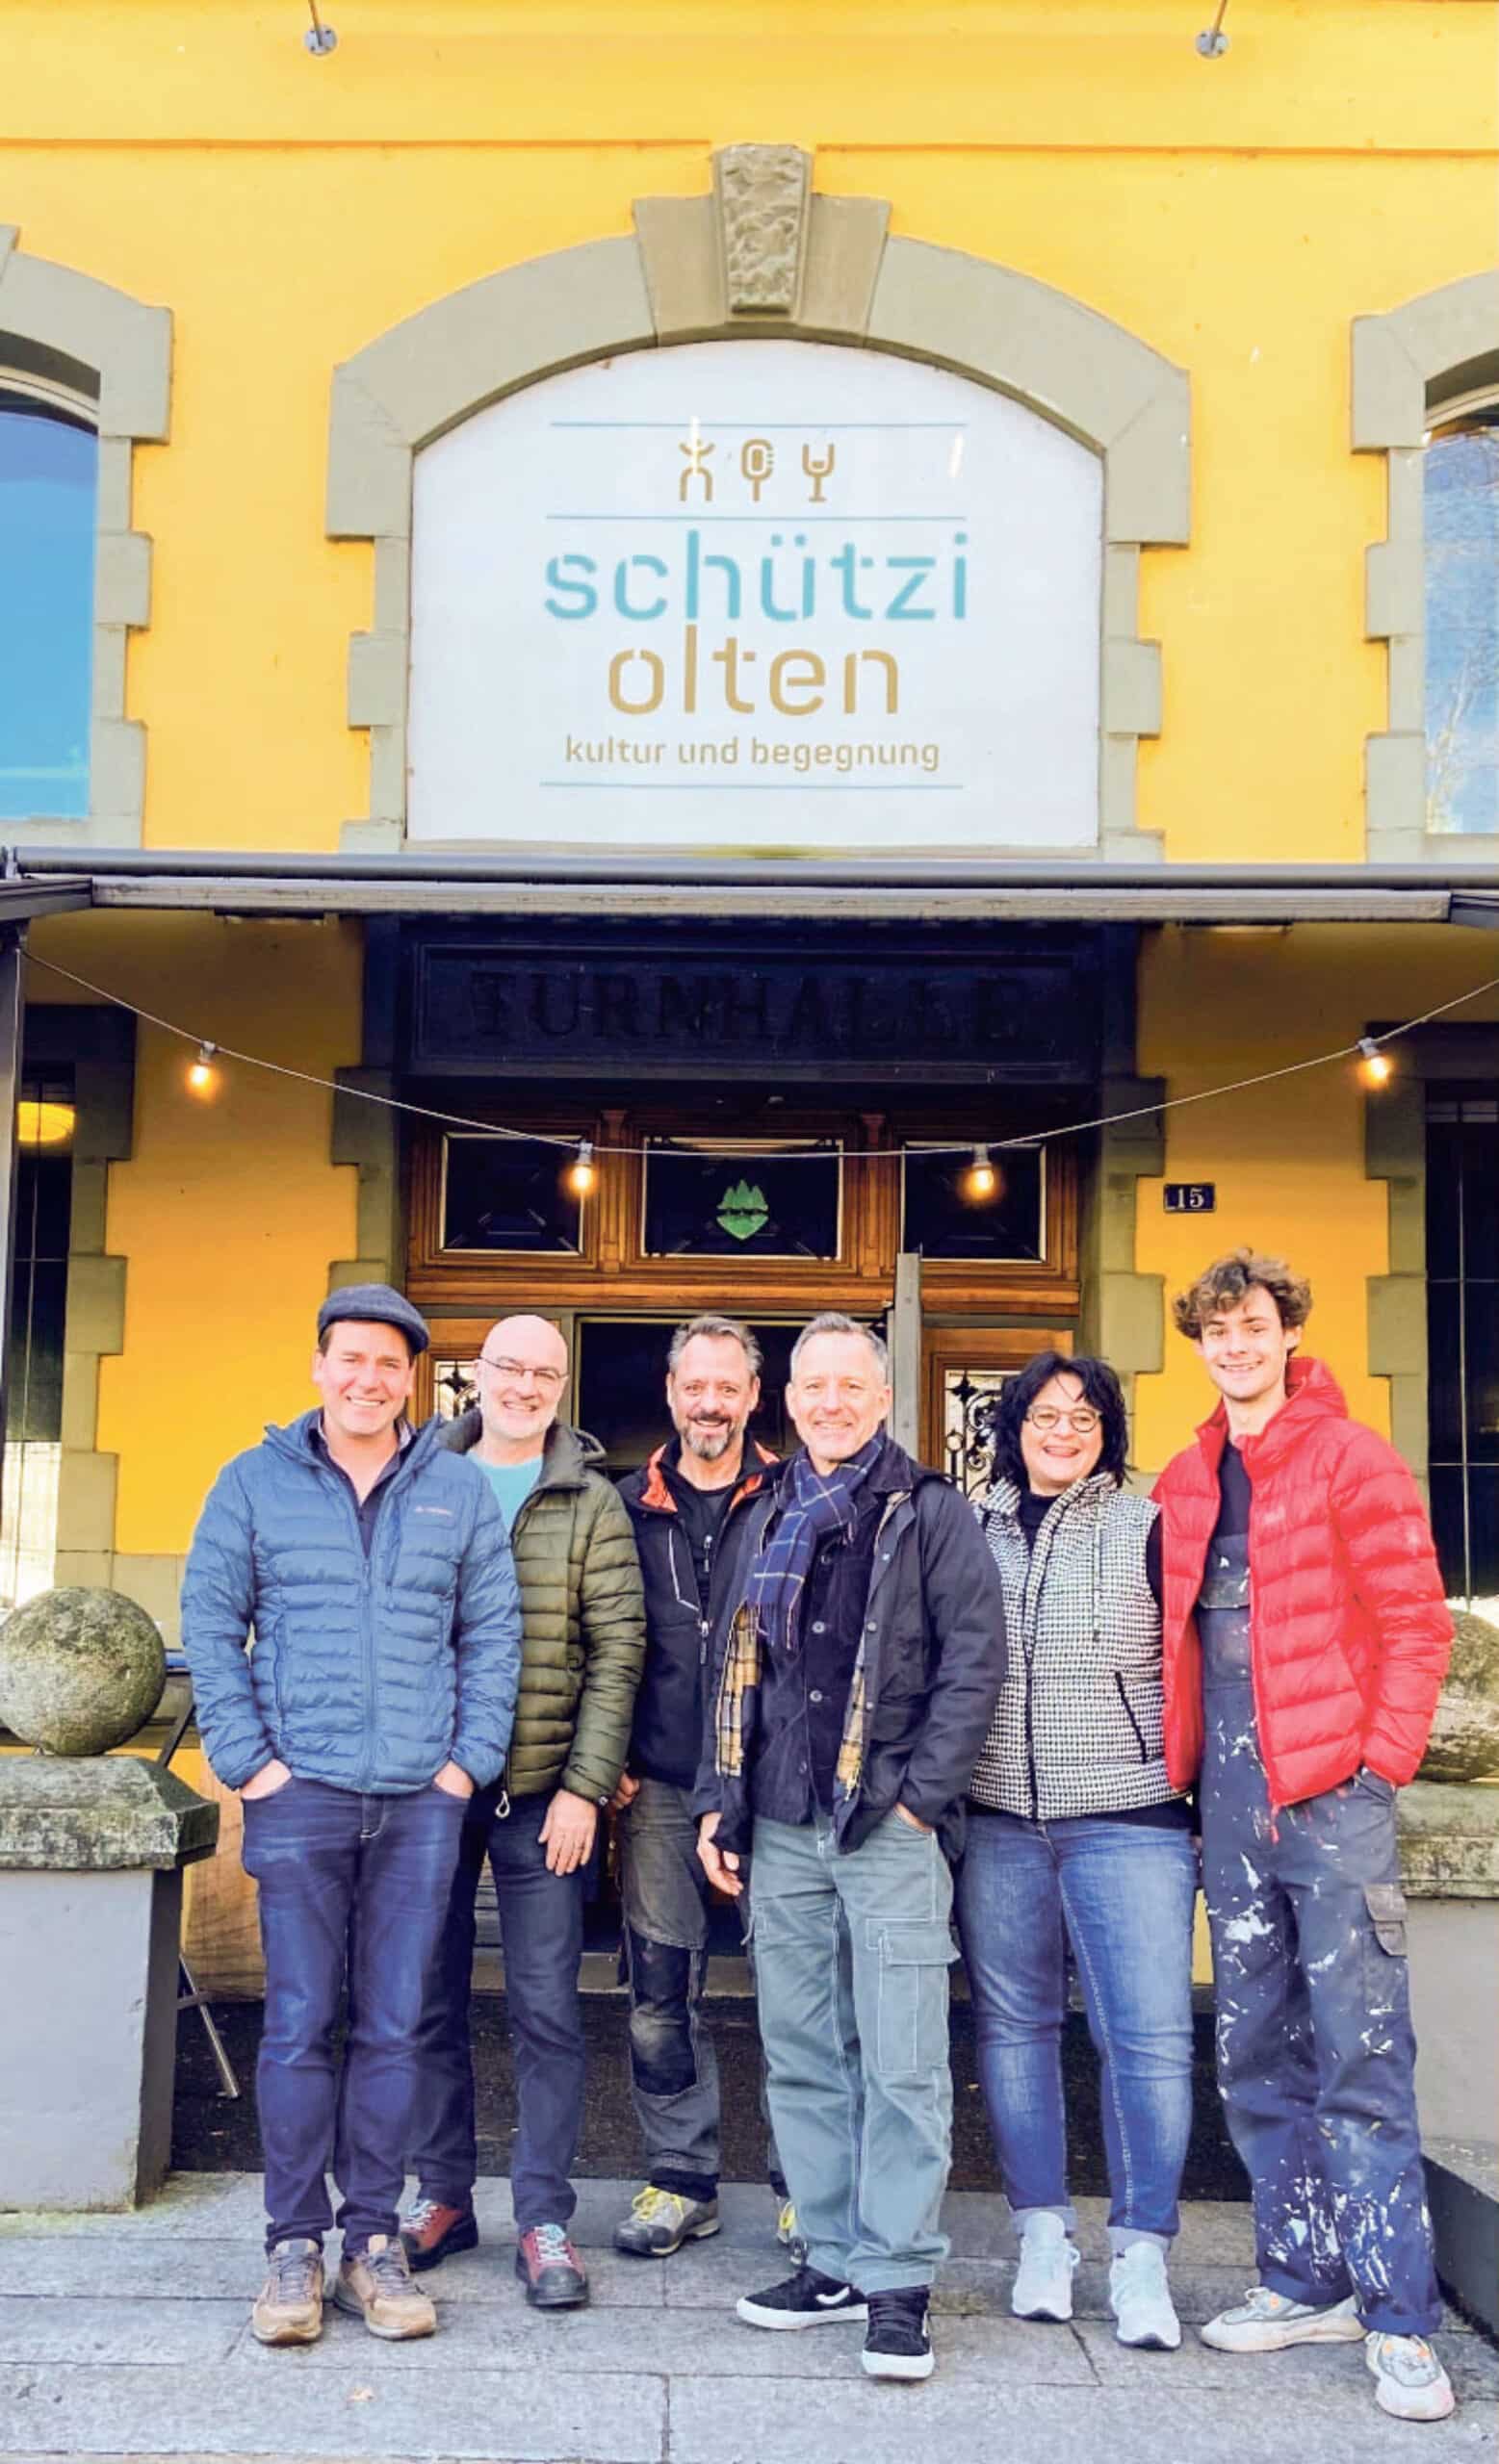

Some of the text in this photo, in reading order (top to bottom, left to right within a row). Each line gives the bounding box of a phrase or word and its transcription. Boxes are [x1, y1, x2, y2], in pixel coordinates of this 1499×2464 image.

[544, 528, 969, 622] schützi
[607, 624, 899, 716] olten
[564, 735, 941, 773] kultur und begegnung
[468, 969, 1026, 1045] TURNHALLE
[1177, 1187, 1204, 1208] 15
